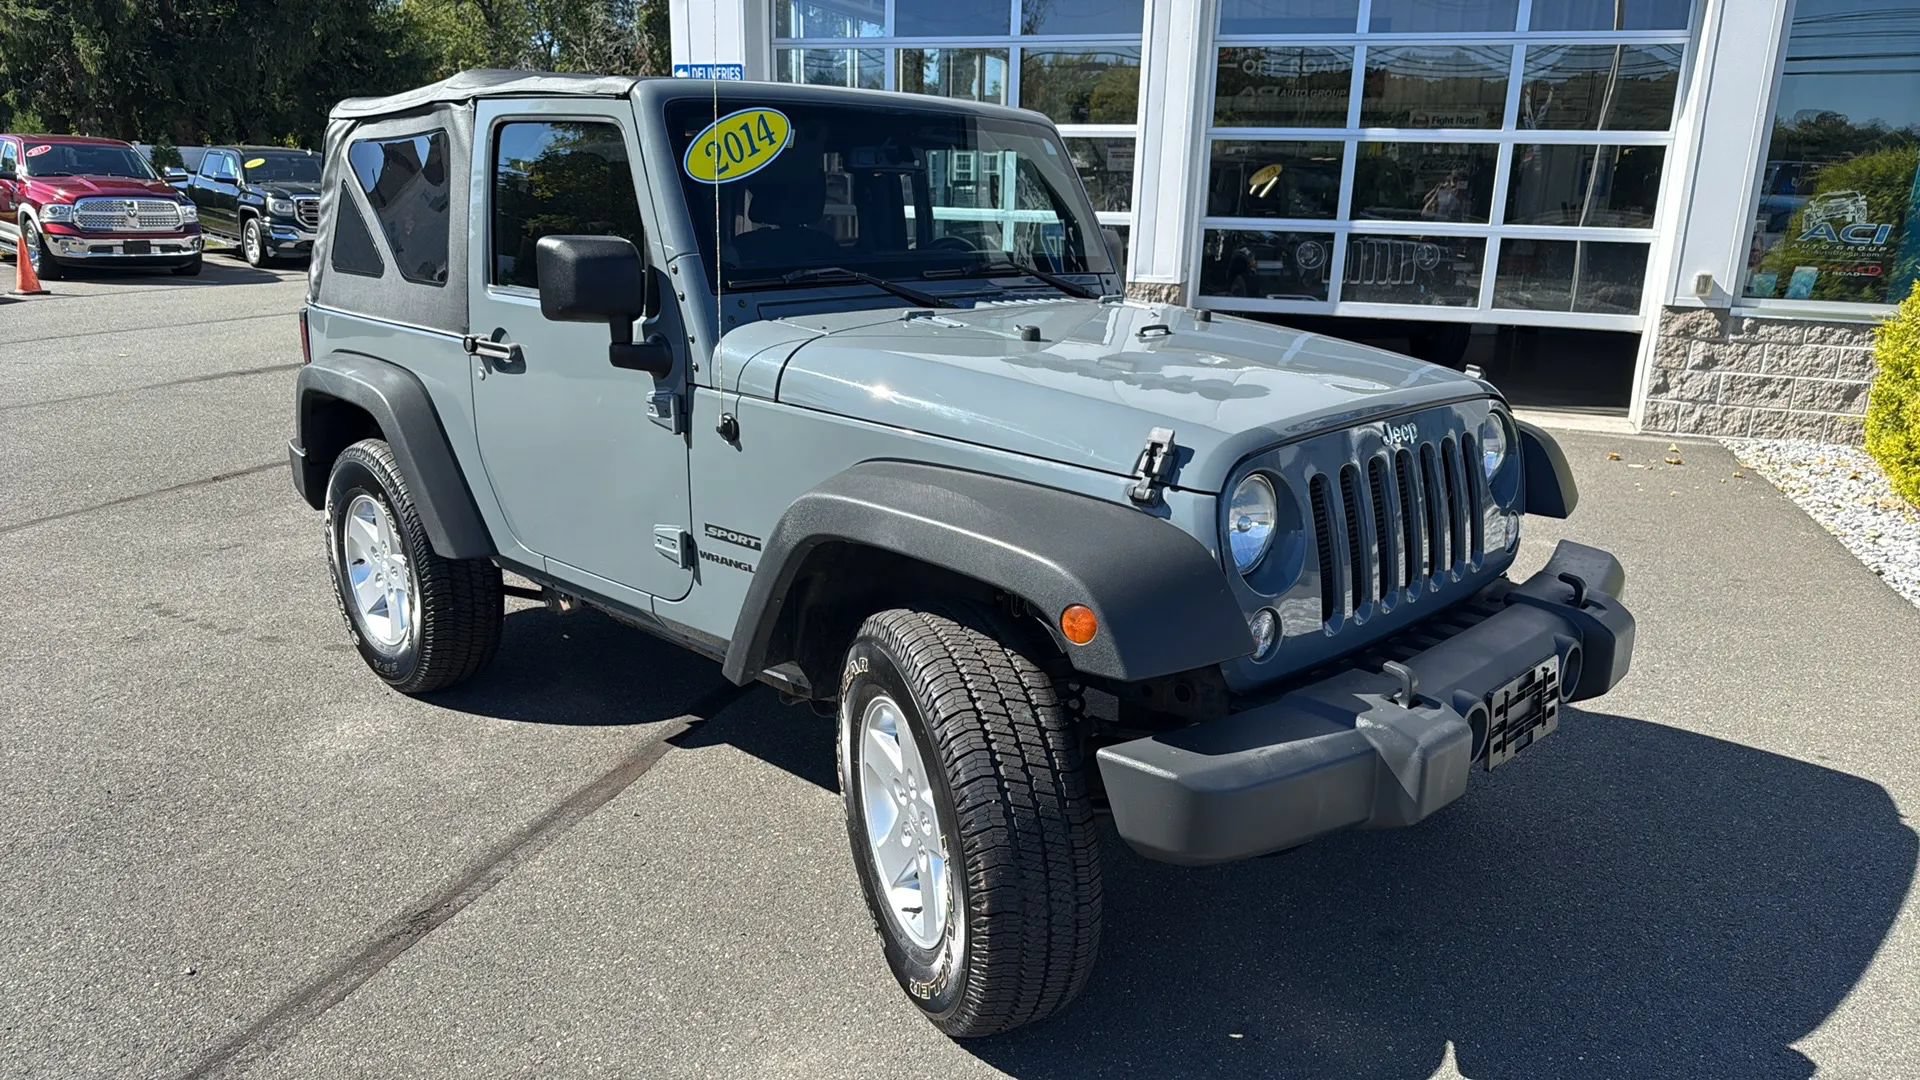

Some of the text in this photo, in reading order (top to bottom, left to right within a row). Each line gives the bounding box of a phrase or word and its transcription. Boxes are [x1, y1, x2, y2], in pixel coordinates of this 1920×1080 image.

[691, 66, 741, 80] DELIVERIES
[1280, 89, 1307, 97] AUTO
[1310, 88, 1347, 98] GROUP
[705, 113, 777, 176] 2014
[1796, 221, 1893, 244] ACI
[1836, 244, 1888, 252] GROUP
[1383, 422, 1417, 445] Jeep
[706, 525, 761, 549] SPORT
